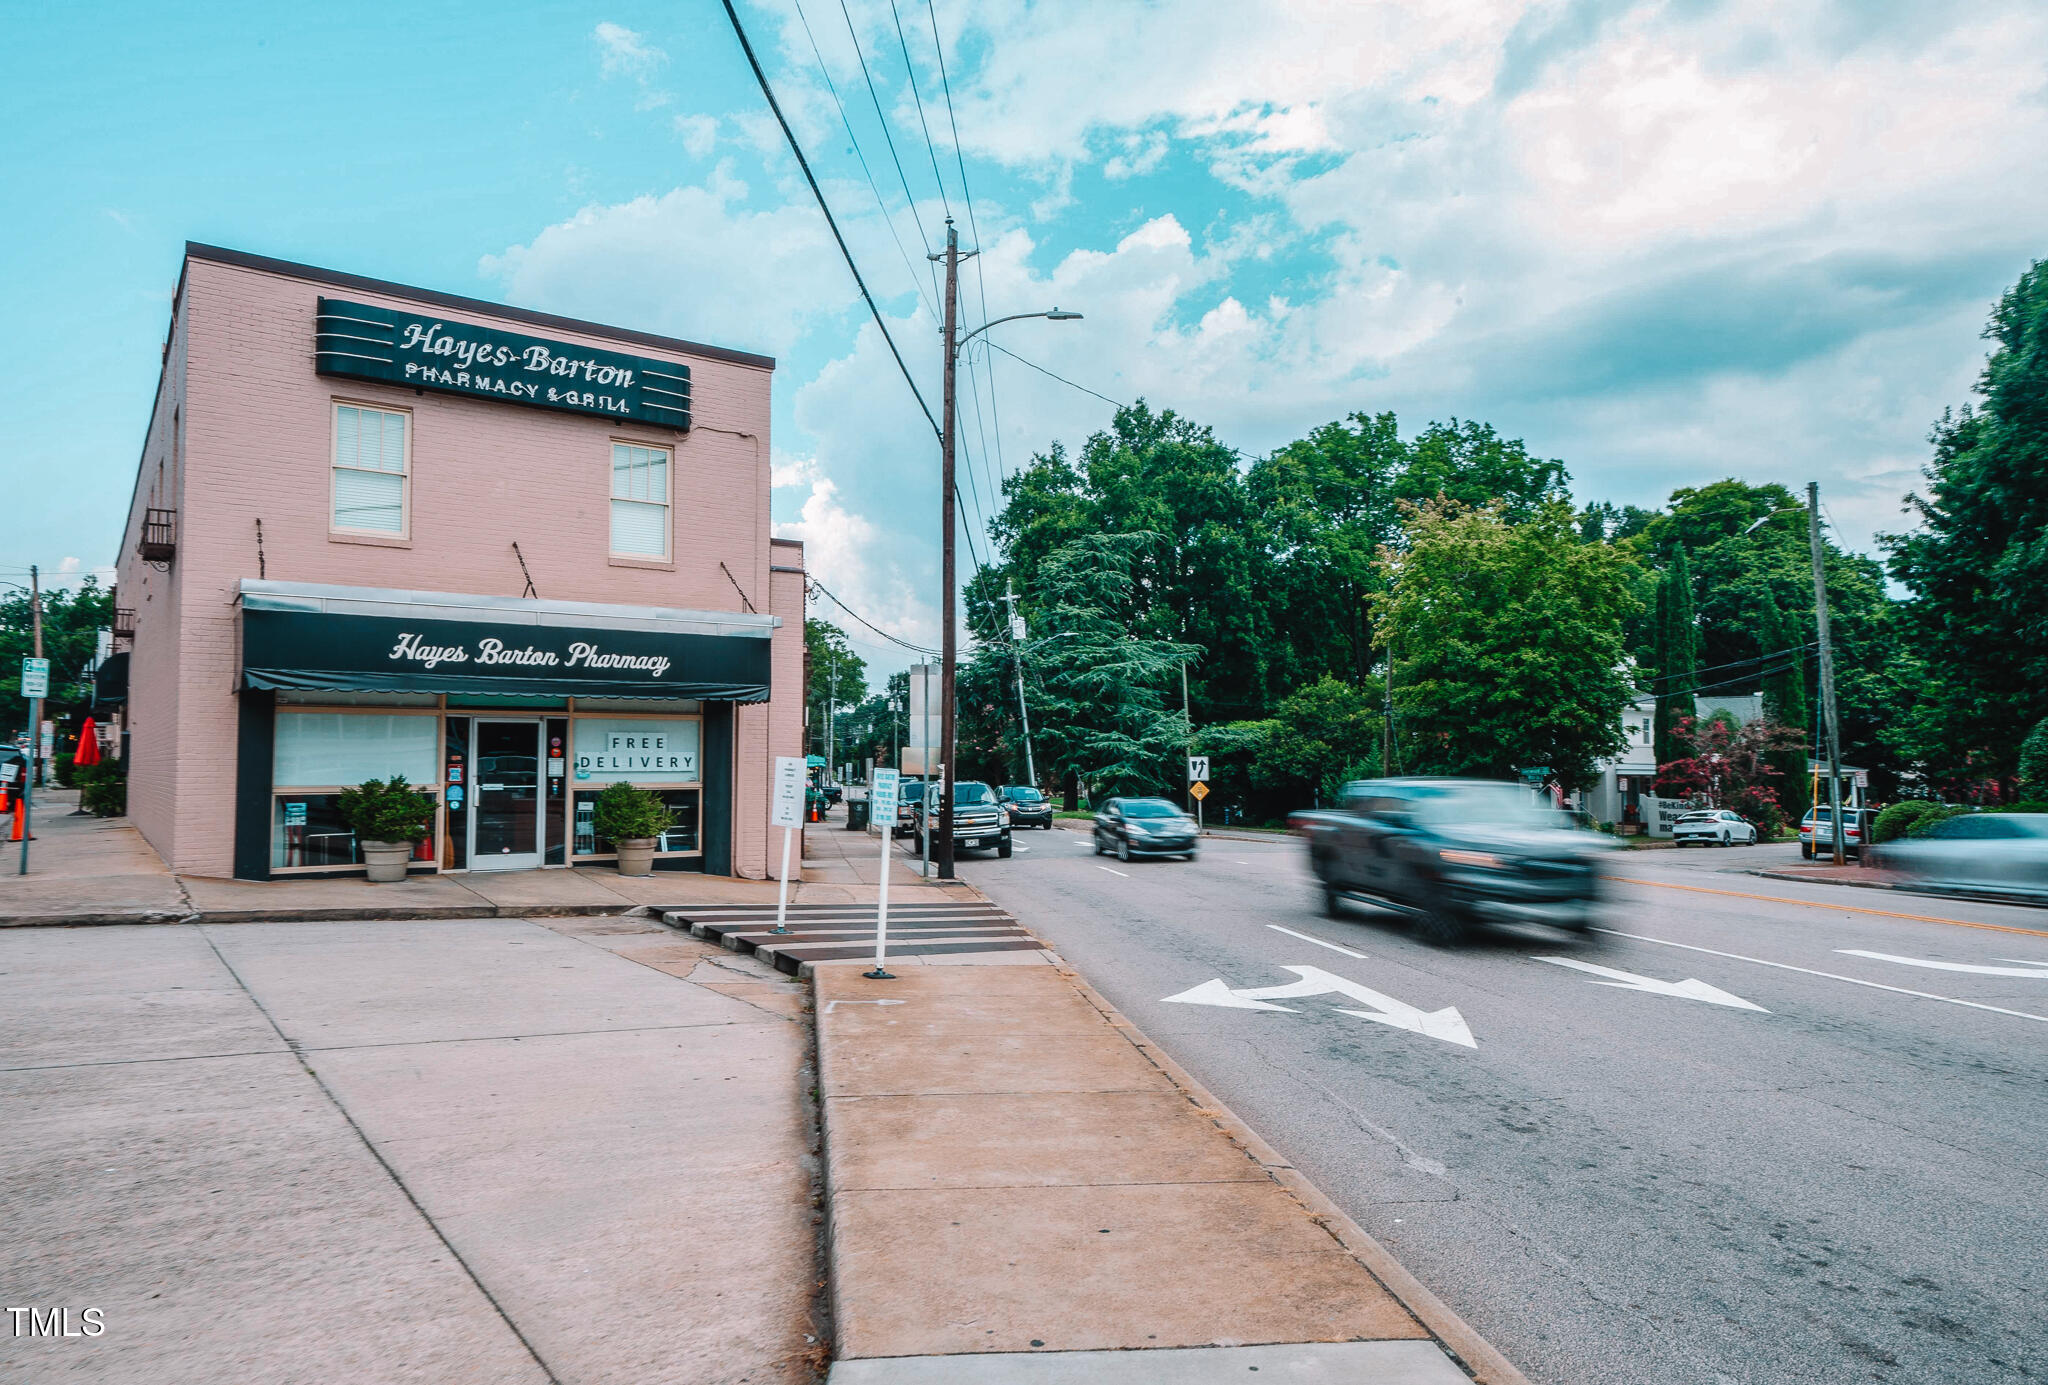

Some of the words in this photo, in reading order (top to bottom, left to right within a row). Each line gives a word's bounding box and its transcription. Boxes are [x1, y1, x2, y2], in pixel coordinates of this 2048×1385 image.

[405, 362, 539, 398] PHARMACY
[547, 386, 560, 402] &
[566, 390, 630, 414] GRILL
[389, 633, 469, 669] Hayes
[474, 638, 559, 665] Barton
[564, 642, 671, 677] Pharmacy
[612, 738, 664, 749] FREE
[580, 757, 693, 768] DELIVERY
